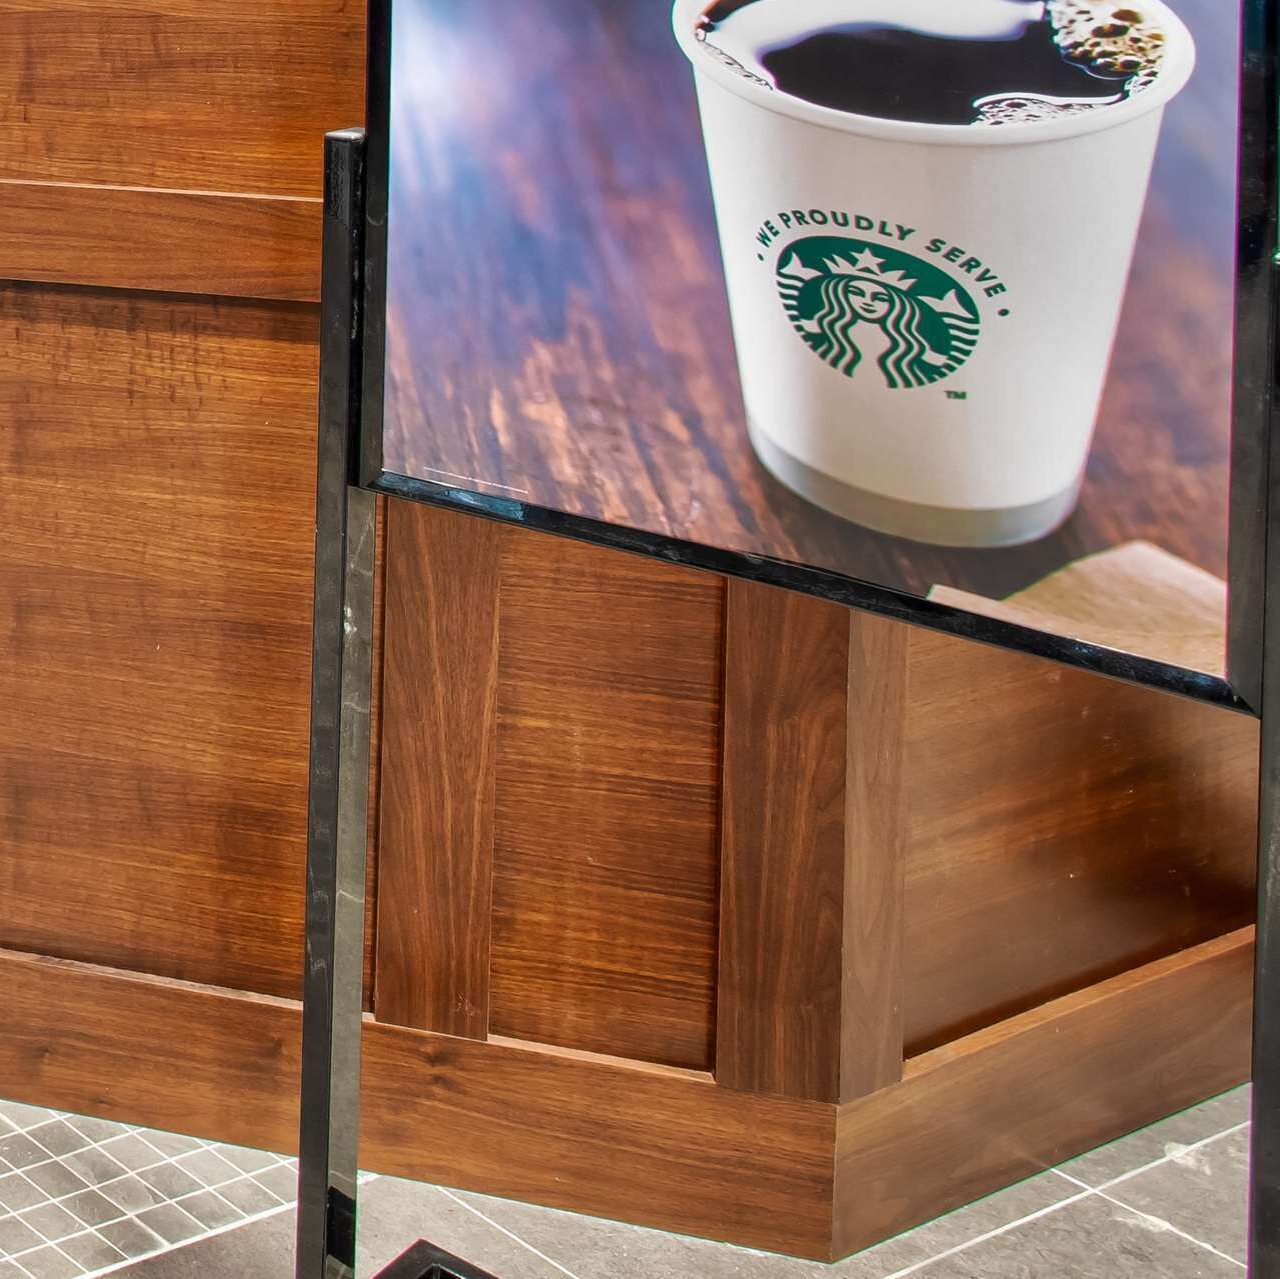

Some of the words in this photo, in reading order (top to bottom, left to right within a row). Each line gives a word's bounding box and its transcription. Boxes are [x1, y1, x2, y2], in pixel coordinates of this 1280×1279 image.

[755, 219, 780, 249] WE
[777, 208, 917, 242] PROUDLY
[923, 237, 1008, 299] SERVE
